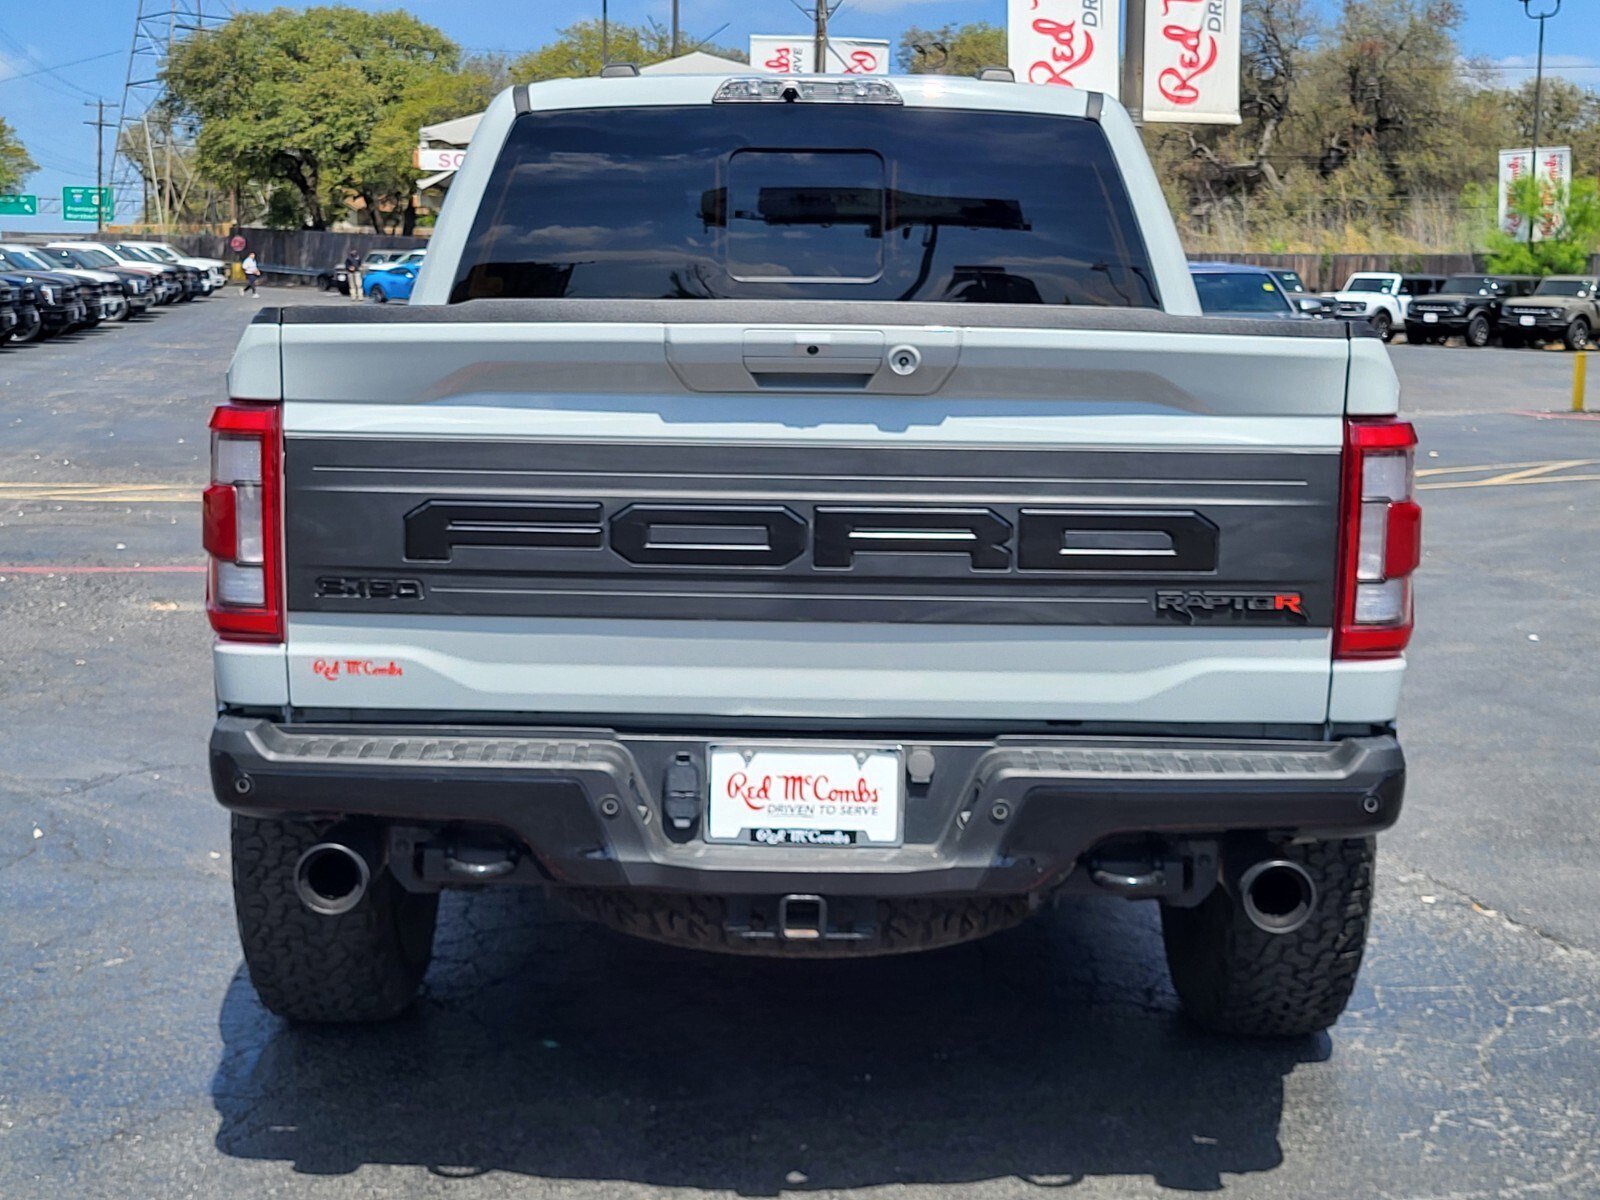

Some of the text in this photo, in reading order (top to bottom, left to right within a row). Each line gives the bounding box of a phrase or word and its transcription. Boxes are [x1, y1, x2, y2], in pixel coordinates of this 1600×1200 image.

[1158, 25, 1218, 105] Red
[403, 500, 1219, 573] FORD
[1156, 590, 1306, 618] RAPTOR
[313, 657, 339, 681] Red
[727, 772, 878, 810] Red McCombs
[767, 803, 879, 817] DRIVEN TO SERVE
